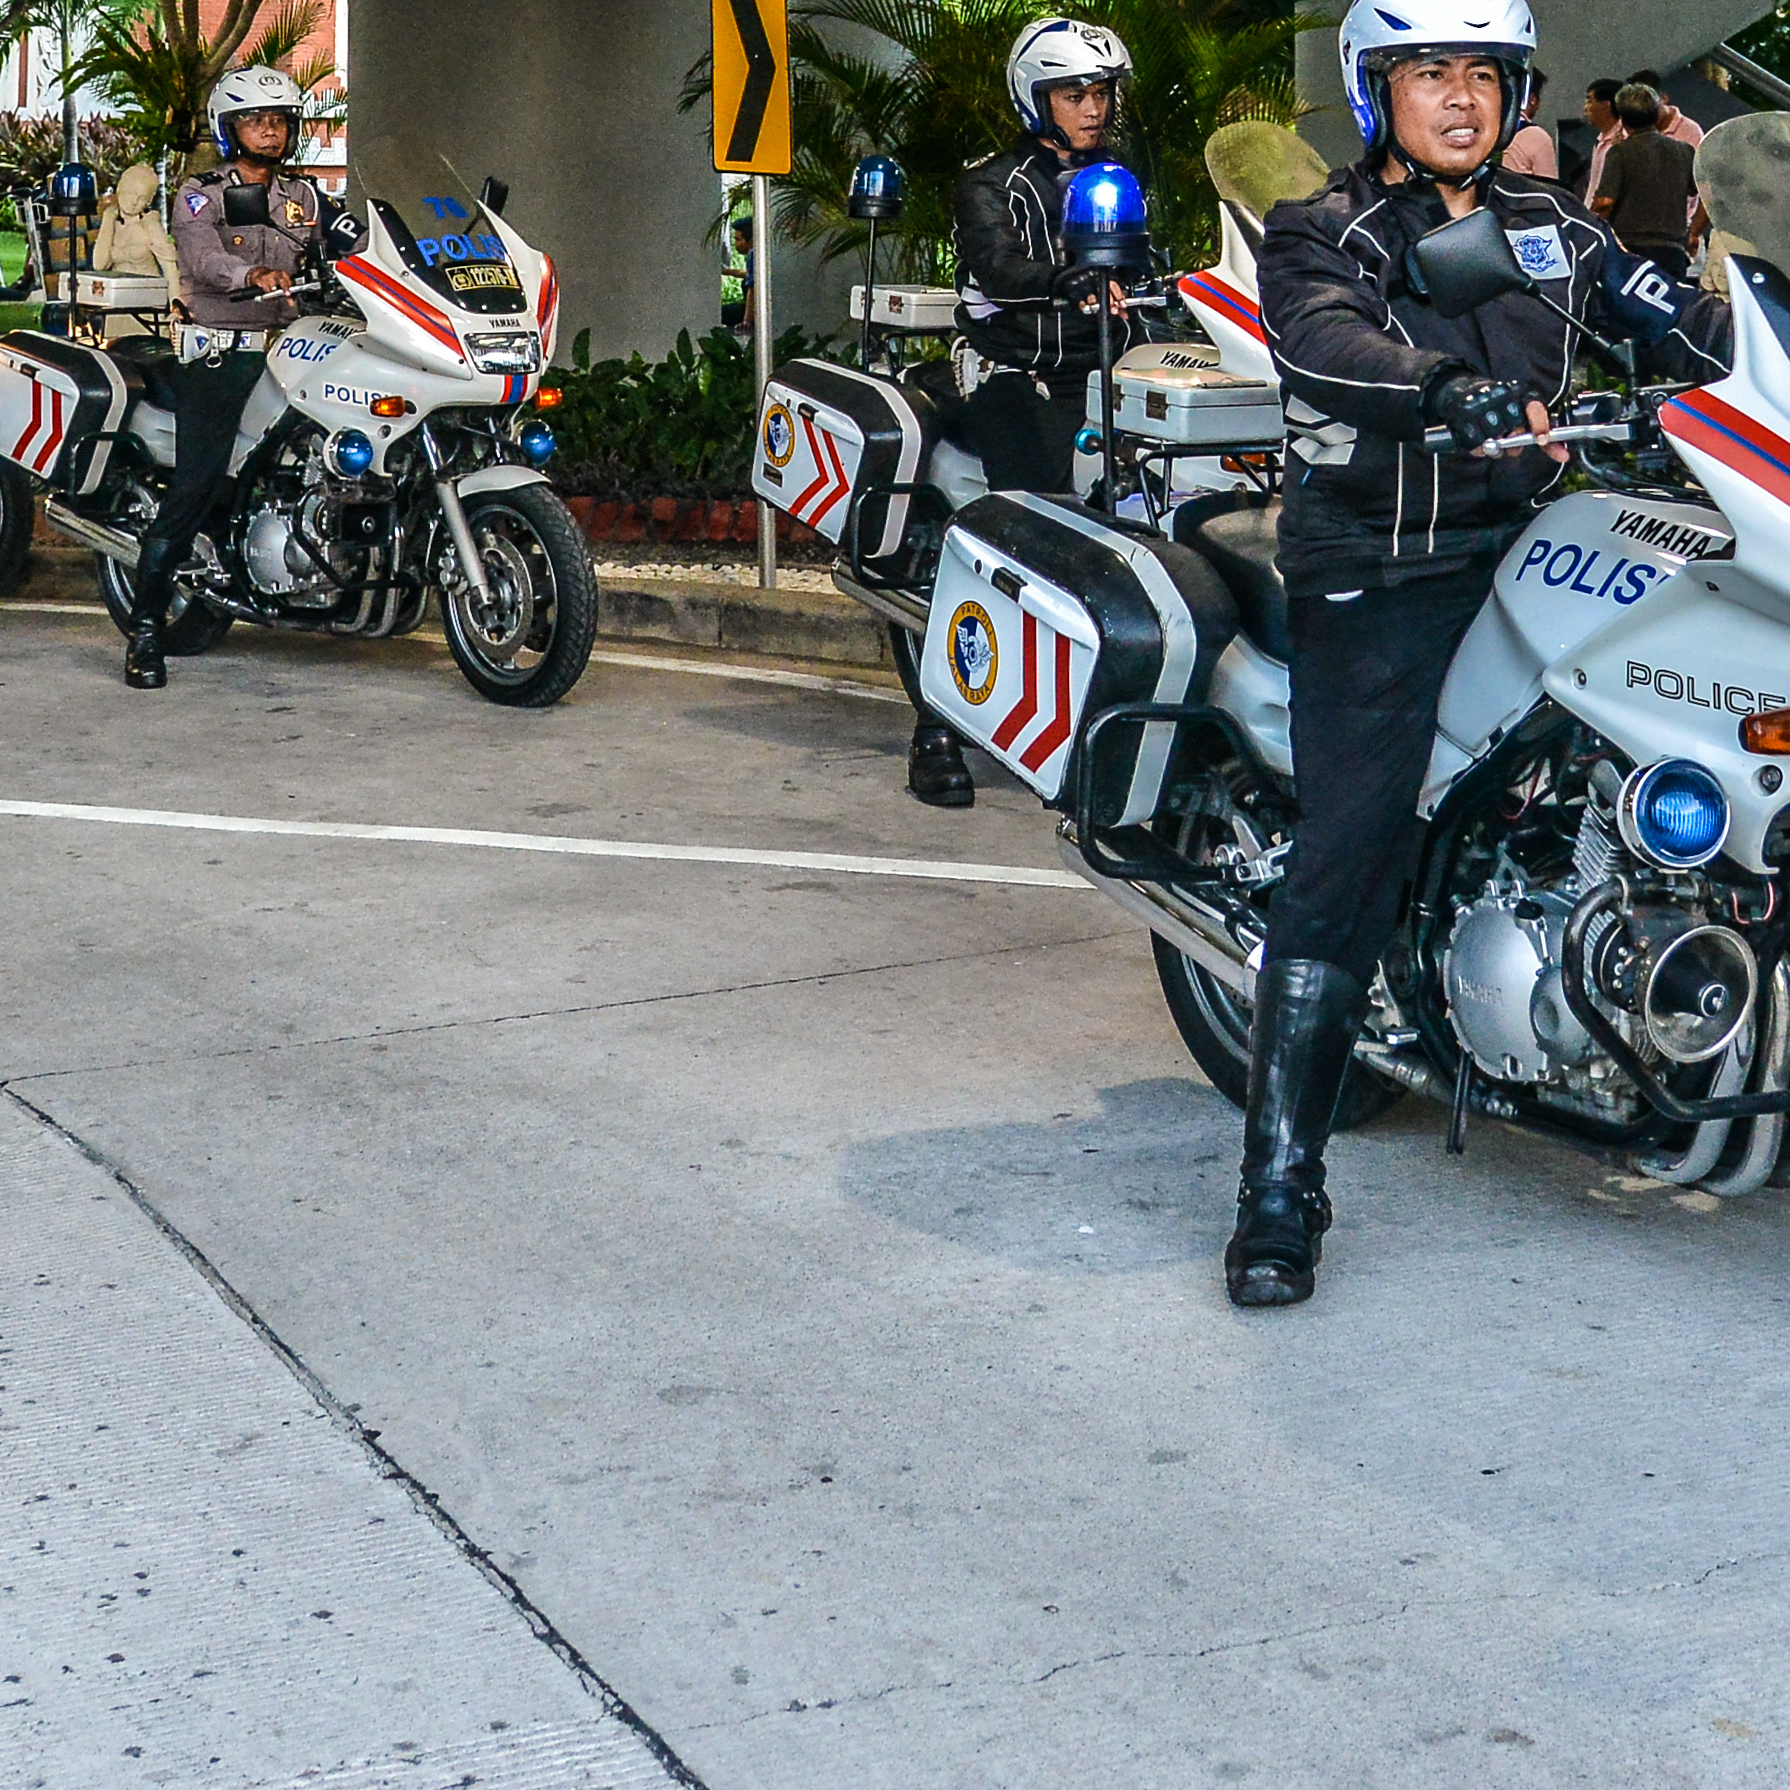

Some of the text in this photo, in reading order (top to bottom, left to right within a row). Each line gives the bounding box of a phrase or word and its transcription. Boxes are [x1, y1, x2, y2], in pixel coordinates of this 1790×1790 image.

[489, 319, 521, 328] YAMAHA
[1610, 509, 1713, 561] YAMAHA
[1515, 539, 1672, 606] POLIS
